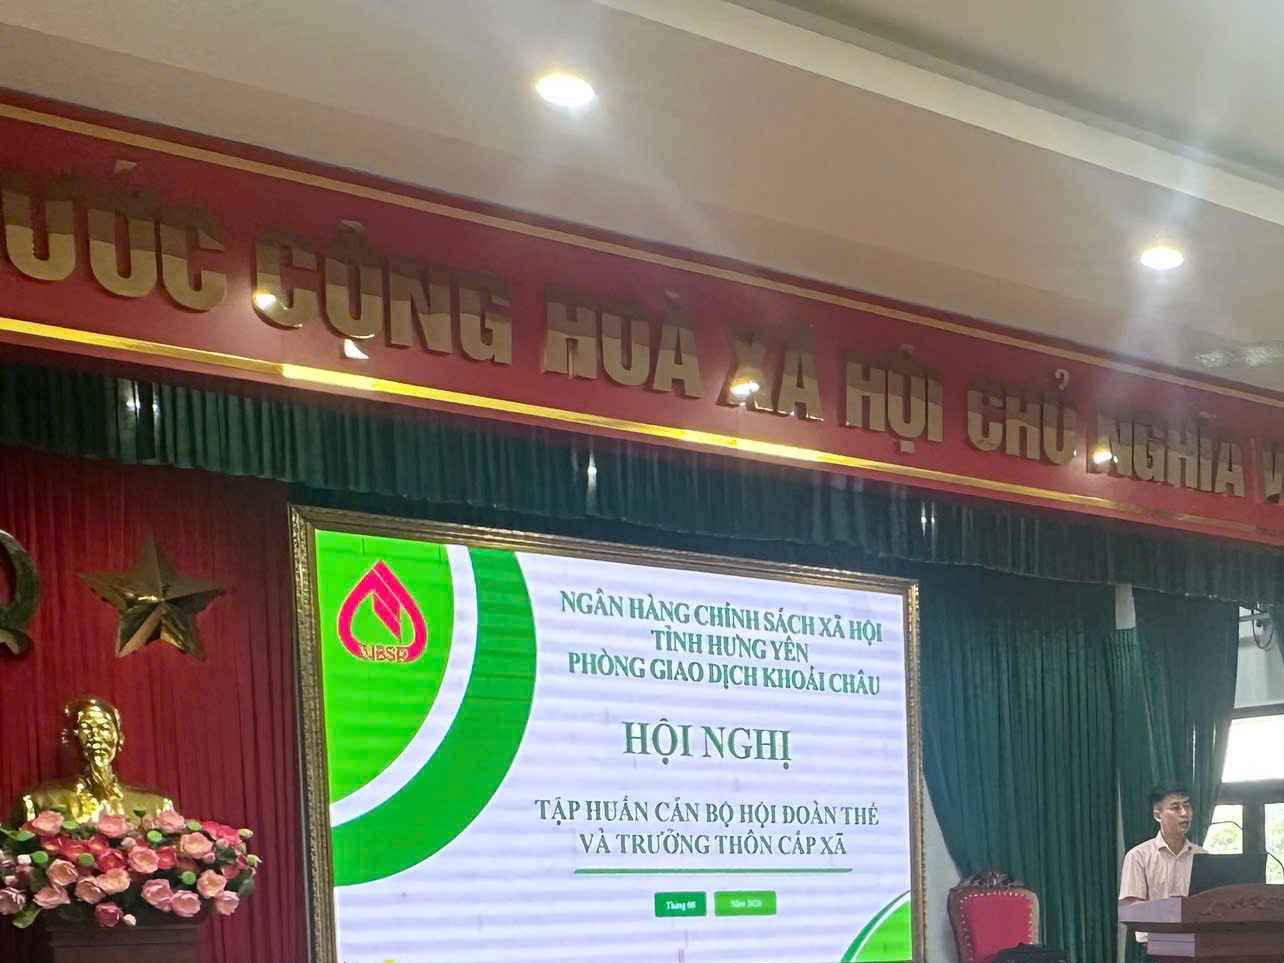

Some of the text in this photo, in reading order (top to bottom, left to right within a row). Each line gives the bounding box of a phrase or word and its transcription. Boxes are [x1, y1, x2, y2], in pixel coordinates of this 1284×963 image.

[254, 219, 512, 364] CỘNG
[845, 344, 943, 453] HỘI
[966, 369, 1078, 465] CHỦ
[559, 588, 883, 646] NGÂN HÀNG CHÍNH SÁCH XÃ HỘI
[568, 648, 880, 695] PHÒNG GIAO DỊCH KHOÁI CHÂU
[706, 634, 767, 660] HƯNG
[770, 636, 809, 663] YÊN
[621, 717, 792, 770] HỘI NGHỊ
[534, 796, 581, 826] TẬP
[705, 801, 734, 828] BỘ
[740, 801, 777, 828] HỘI
[579, 827, 611, 854] VÀ
[714, 829, 773, 855] THÔN
[820, 832, 847, 855] XÃ
